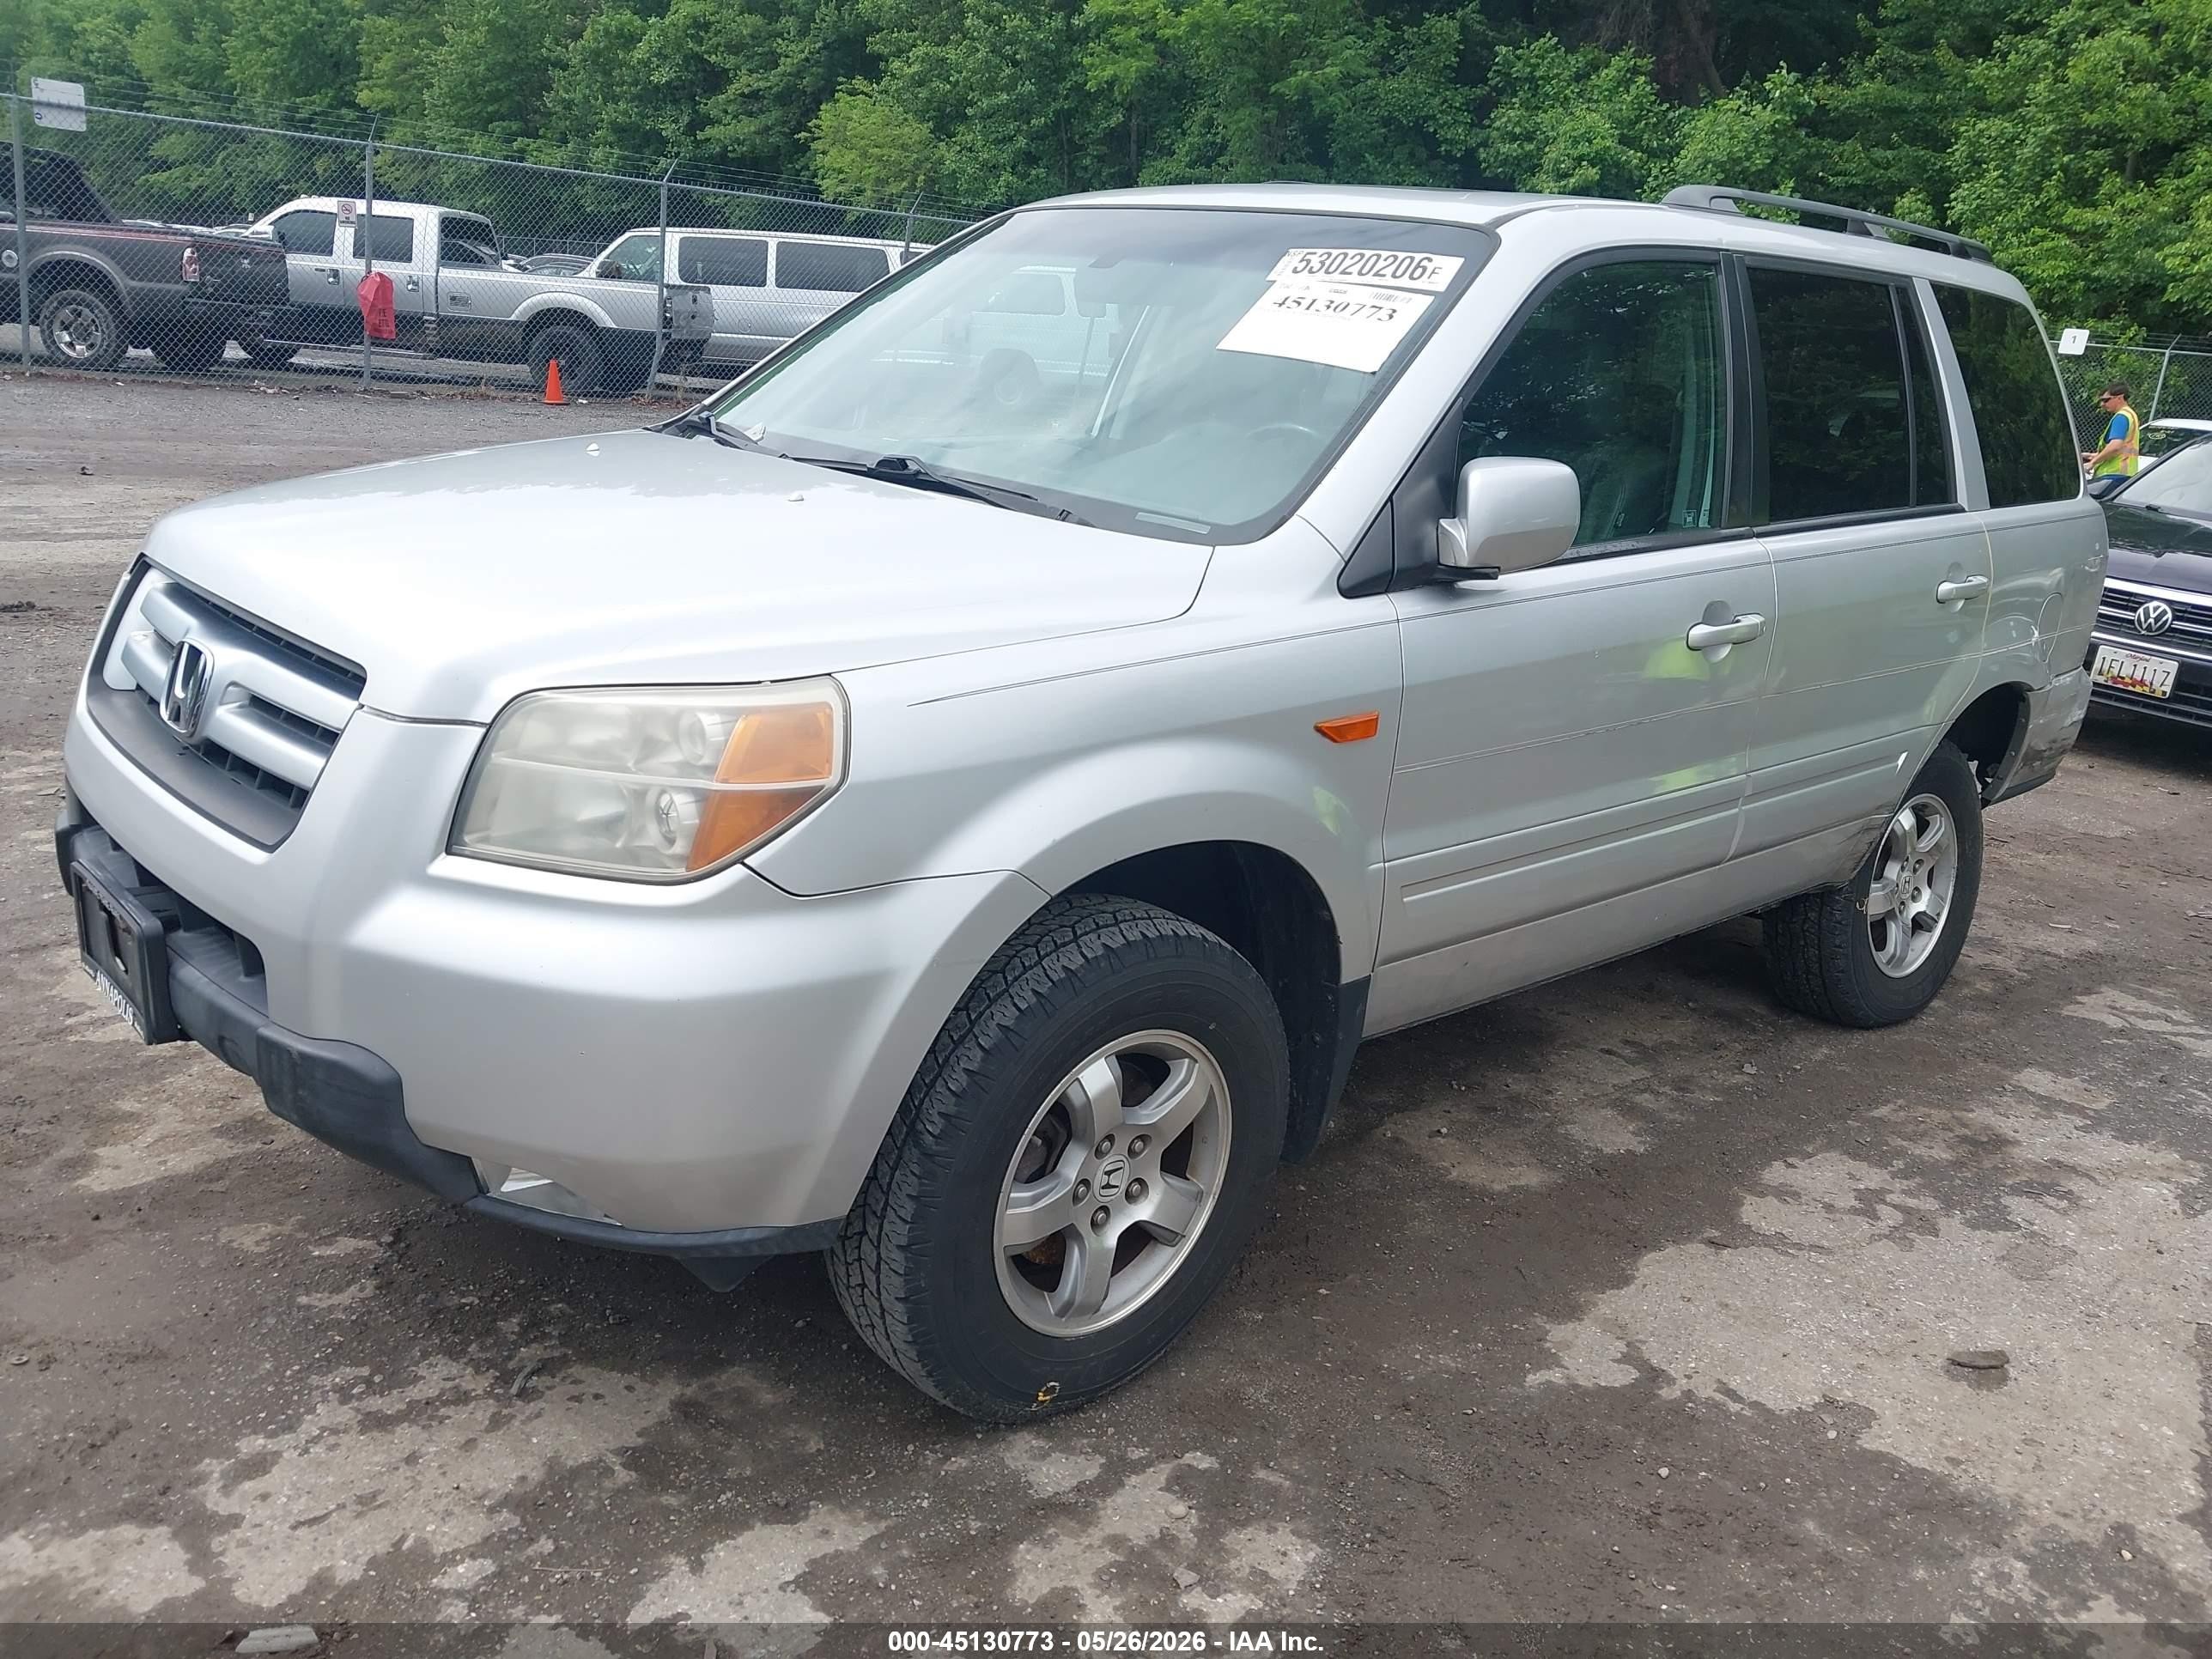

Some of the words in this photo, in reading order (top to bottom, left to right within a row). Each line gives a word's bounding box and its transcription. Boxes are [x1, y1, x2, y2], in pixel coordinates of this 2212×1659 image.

[1291, 252, 1433, 281] 53020206
[1427, 266, 1443, 279] F
[1273, 295, 1397, 322] 45130773
[2070, 336, 2077, 344] 1
[95, 969, 134, 1026] ANNAPOLIS
